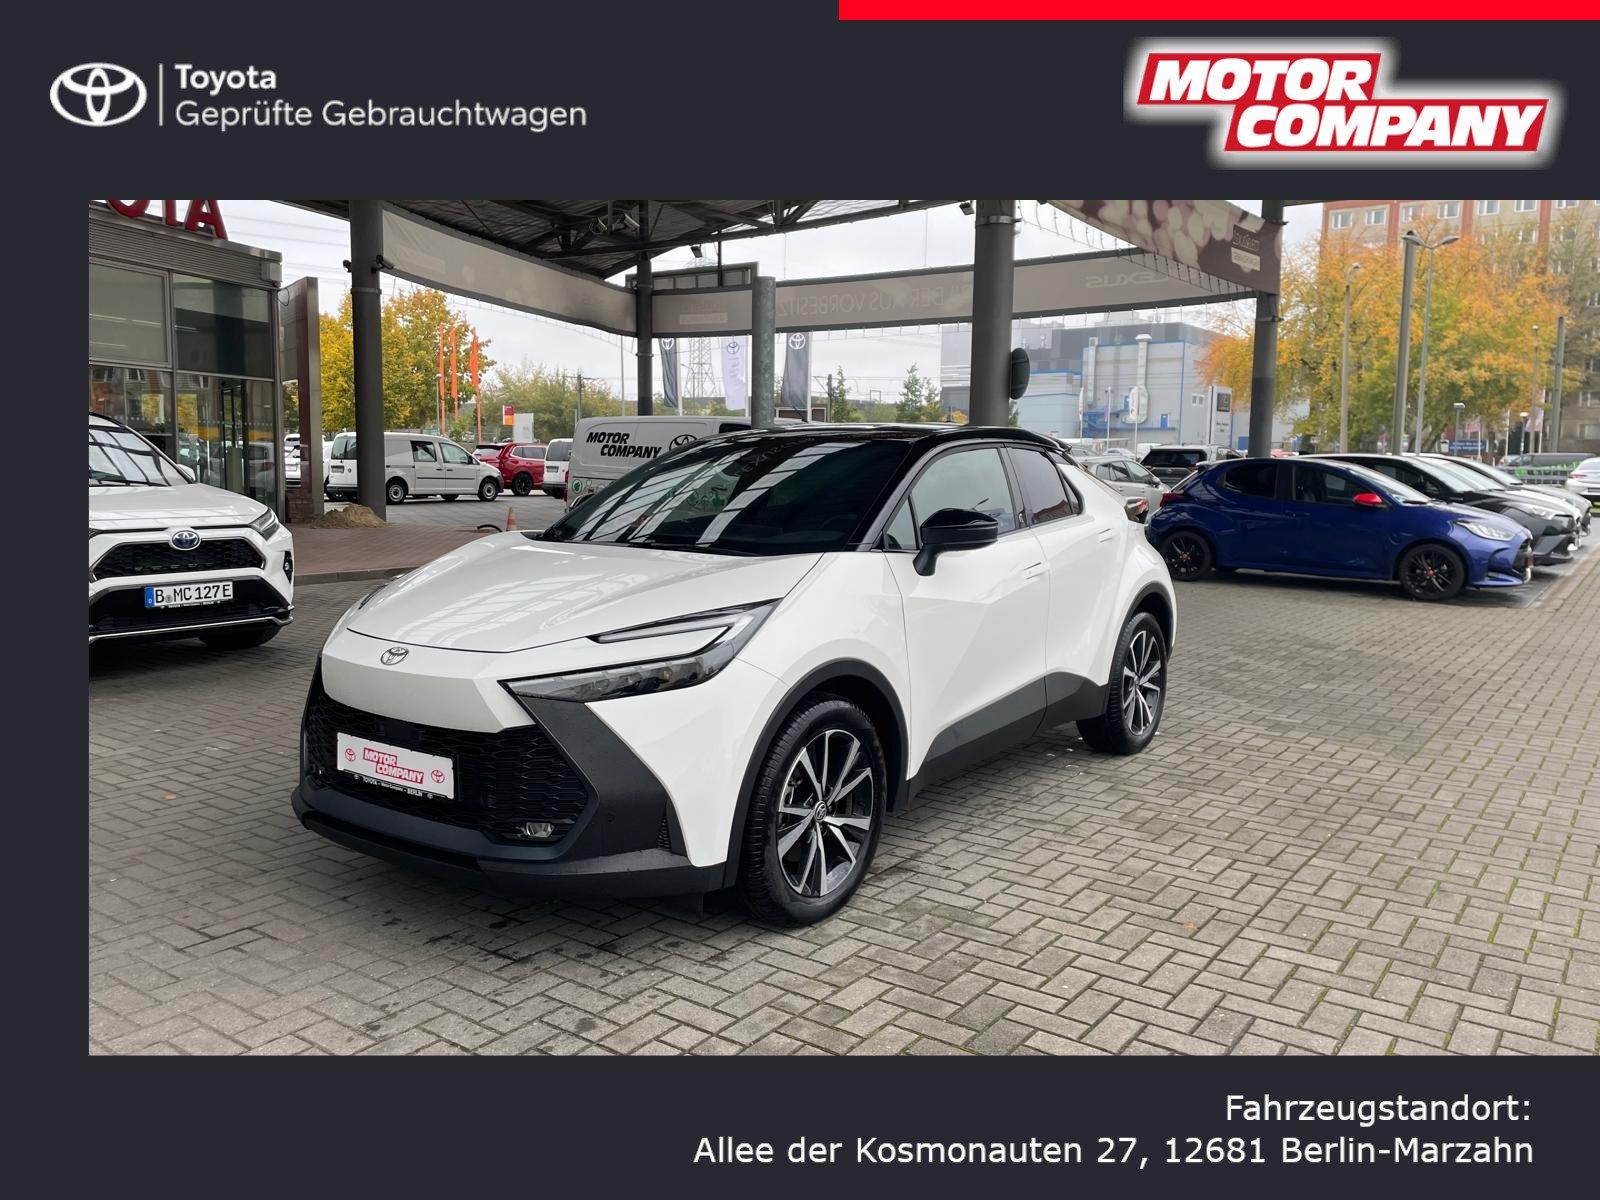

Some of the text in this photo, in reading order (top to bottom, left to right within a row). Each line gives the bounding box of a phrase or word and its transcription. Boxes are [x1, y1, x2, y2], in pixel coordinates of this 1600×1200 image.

[586, 432, 630, 444] MOTOR
[600, 444, 662, 459] COMPANY
[155, 589, 165, 603] B
[173, 587, 192, 602] MC
[364, 749, 397, 766] MOTOR
[376, 763, 424, 783] COMPANY
